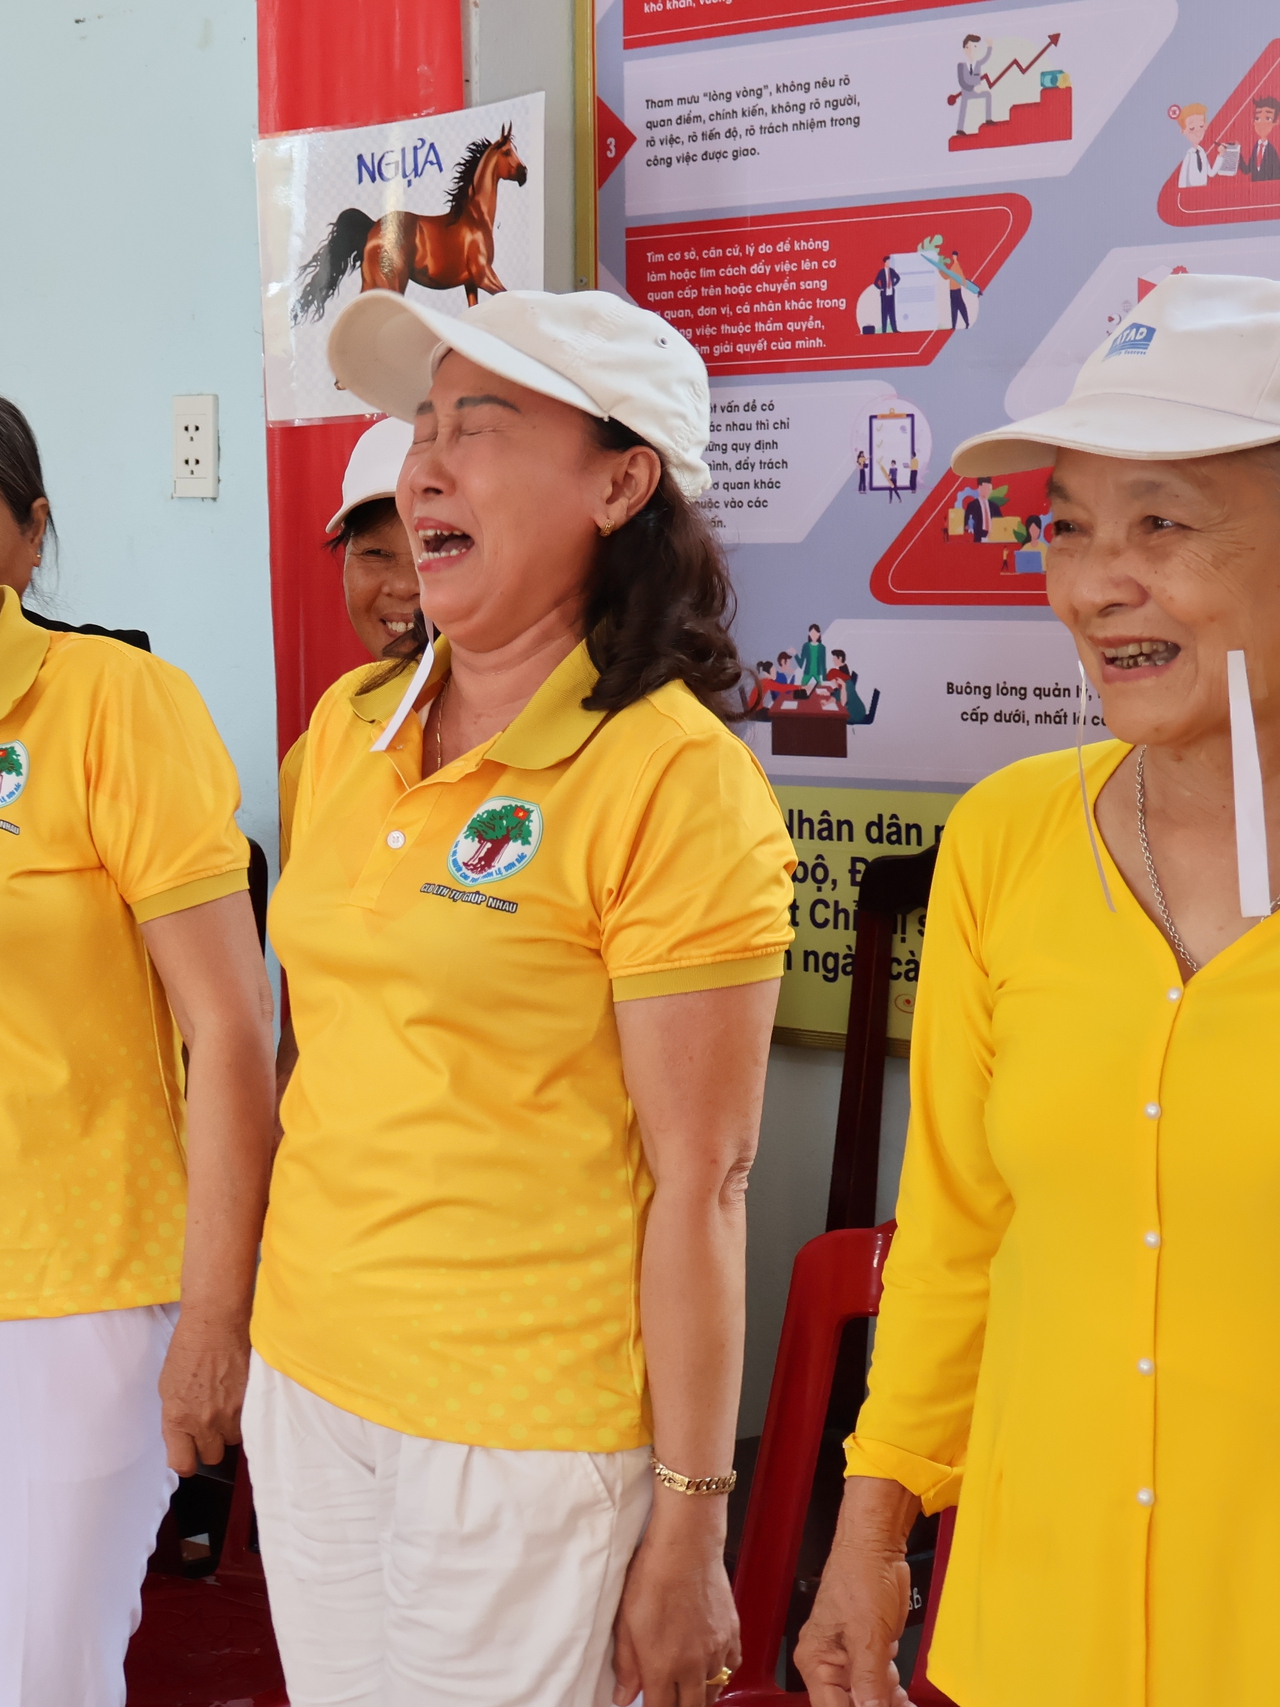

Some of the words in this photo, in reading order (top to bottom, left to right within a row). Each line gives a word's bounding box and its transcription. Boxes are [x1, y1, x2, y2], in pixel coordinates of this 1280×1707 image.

[645, 98, 673, 109] Tham
[677, 95, 699, 105] mưu
[776, 80, 810, 93] không
[815, 77, 835, 89] nêu
[839, 74, 850, 86] rõ
[646, 118, 672, 130] quan
[676, 110, 705, 125] điểm,
[709, 109, 737, 121] chính
[742, 104, 768, 117] kiến,
[772, 101, 805, 114] không
[810, 98, 820, 110] rõ
[825, 94, 860, 110] người,
[646, 136, 655, 147] rõ
[659, 134, 684, 147] việc,
[688, 132, 697, 142] rõ
[701, 128, 720, 141] tiến
[725, 127, 741, 141] độ,
[746, 125, 755, 136] rõ
[760, 122, 788, 135] trách
[792, 118, 826, 132] nhiệm
[831, 116, 860, 127] trong
[606, 138, 616, 158] 3
[646, 155, 672, 168] công
[676, 152, 697, 166] việc
[701, 150, 728, 162] được
[732, 147, 759, 160] giao.
[356, 137, 443, 188] NGỰA
[647, 251, 664, 263] Tìm
[668, 251, 681, 261] cơ
[684, 247, 699, 261] sở,
[702, 247, 722, 258] căn
[726, 244, 742, 256] cứ,
[746, 243, 755, 256] lý
[758, 243, 773, 253] do
[776, 237, 791, 252] để
[794, 238, 829, 252] không
[647, 272, 666, 282] làm
[670, 269, 696, 282] hoặc
[700, 268, 716, 277] tìm
[719, 265, 746, 276] cách
[750, 260, 771, 275] đẩy
[775, 260, 797, 274] việc
[801, 259, 818, 270] lên
[822, 259, 836, 268] cơ
[647, 291, 674, 302] quan
[677, 285, 698, 299] cấp
[701, 285, 721, 296] trên
[725, 283, 752, 296] hoặc
[756, 276, 796, 293] chuyển
[800, 280, 827, 291] sang
[664, 309, 693, 320] quan,
[697, 306, 716, 316] đơn
[721, 304, 732, 317] vị,
[736, 302, 750, 313] cá
[754, 300, 781, 312] nhân
[785, 298, 812, 310] khác
[816, 298, 846, 310] trong
[696, 325, 717, 338] việc
[721, 322, 751, 336] thuộc
[755, 317, 783, 332] thẩm
[787, 315, 825, 332] quyền,
[713, 341, 733, 356] giải
[736, 338, 767, 354] quyết
[771, 338, 791, 350] của
[795, 337, 826, 348] mình.
[720, 401, 739, 413] vấn
[761, 400, 774, 411] có
[710, 421, 722, 432] ác
[726, 421, 752, 432] nhau
[756, 420, 769, 430] thì
[773, 417, 790, 430] chỉ
[731, 442, 750, 452] quy
[754, 440, 778, 453] định
[735, 456, 755, 472] đẩy
[759, 459, 788, 469] trách
[723, 481, 750, 492] quan
[754, 478, 781, 489] khác
[724, 498, 743, 508] vào
[747, 498, 768, 508] các
[946, 682, 991, 699] Buông
[996, 682, 1027, 700] lỏng
[1033, 683, 1070, 700] quản
[961, 706, 988, 724] cấp
[994, 709, 1030, 726] dưới,
[1035, 708, 1068, 725] nhất
[866, 813, 922, 846] dân
[803, 945, 855, 983] ngà
